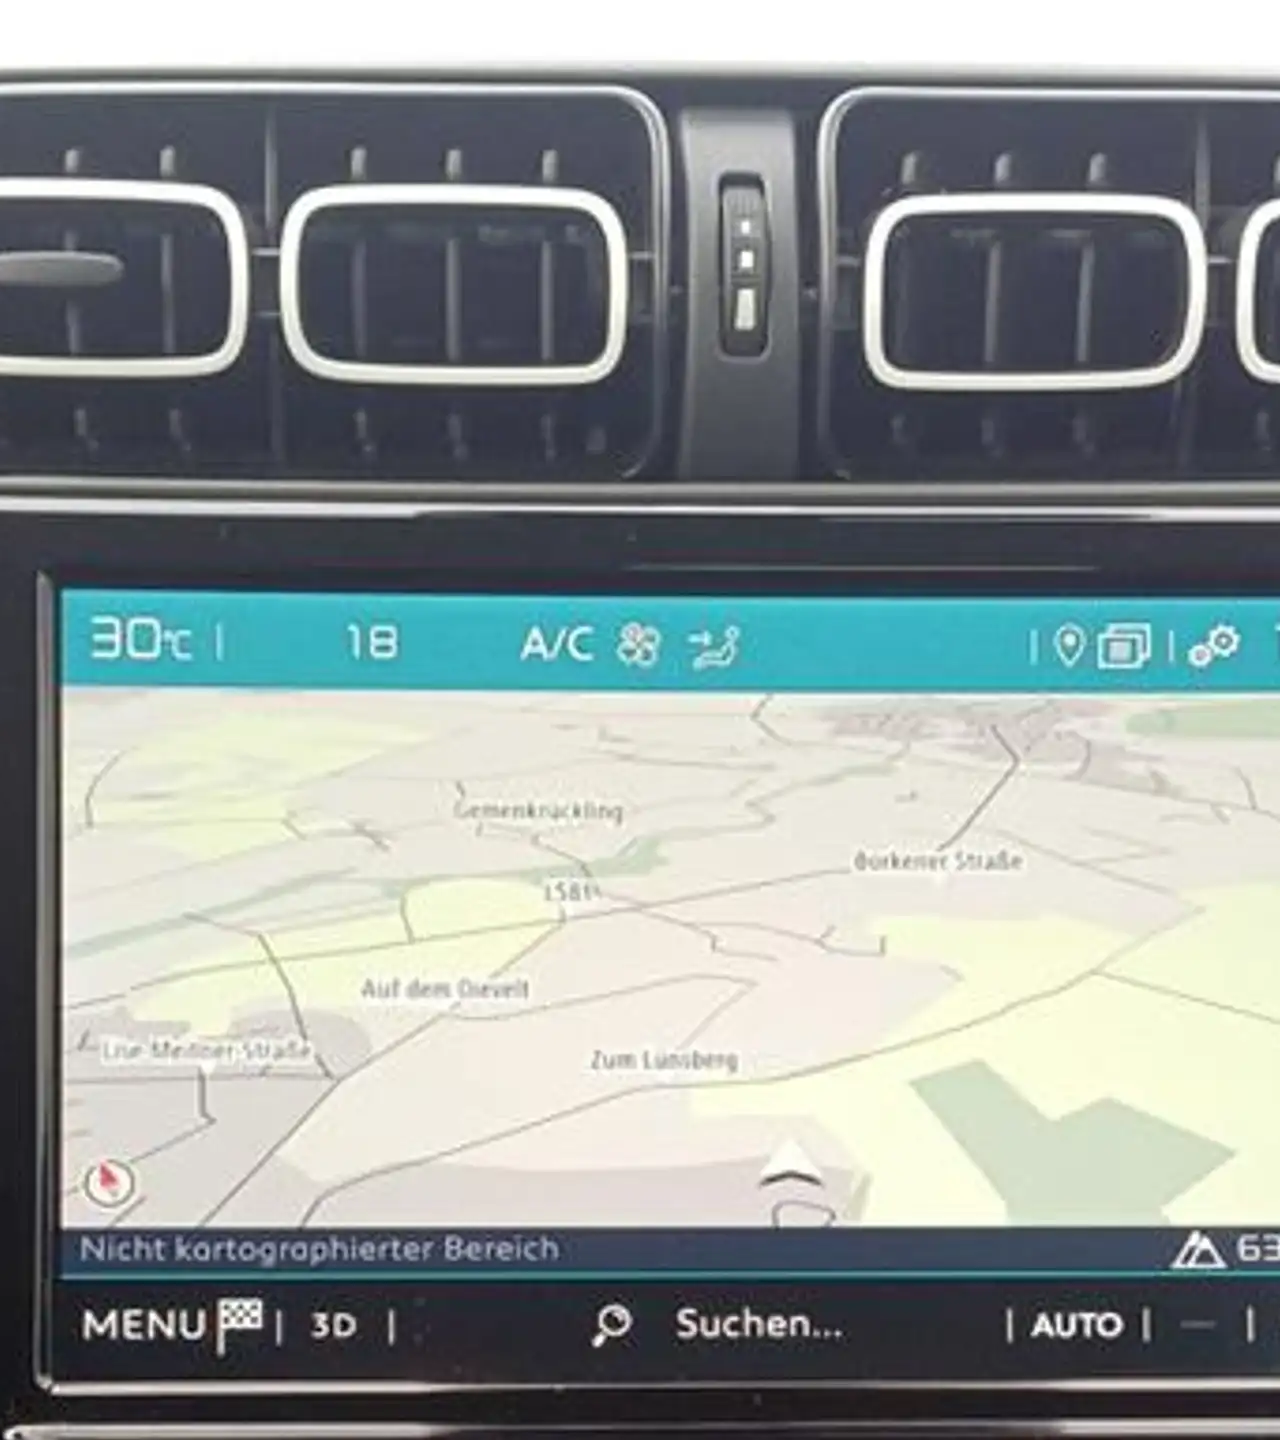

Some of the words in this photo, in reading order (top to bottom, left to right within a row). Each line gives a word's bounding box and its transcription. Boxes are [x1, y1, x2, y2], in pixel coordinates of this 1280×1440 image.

[346, 624, 401, 660] 18
[520, 625, 595, 662] A/C
[360, 977, 402, 1000] Auf
[591, 1049, 638, 1071] Zum
[80, 1236, 166, 1263] Nicht
[175, 1236, 433, 1268] kartographierter
[443, 1235, 560, 1262] Bereich
[83, 1310, 207, 1341] MENU
[310, 1313, 357, 1339] 3D
[676, 1306, 843, 1339] Suchen...
[1030, 1312, 1124, 1339] AUTO
